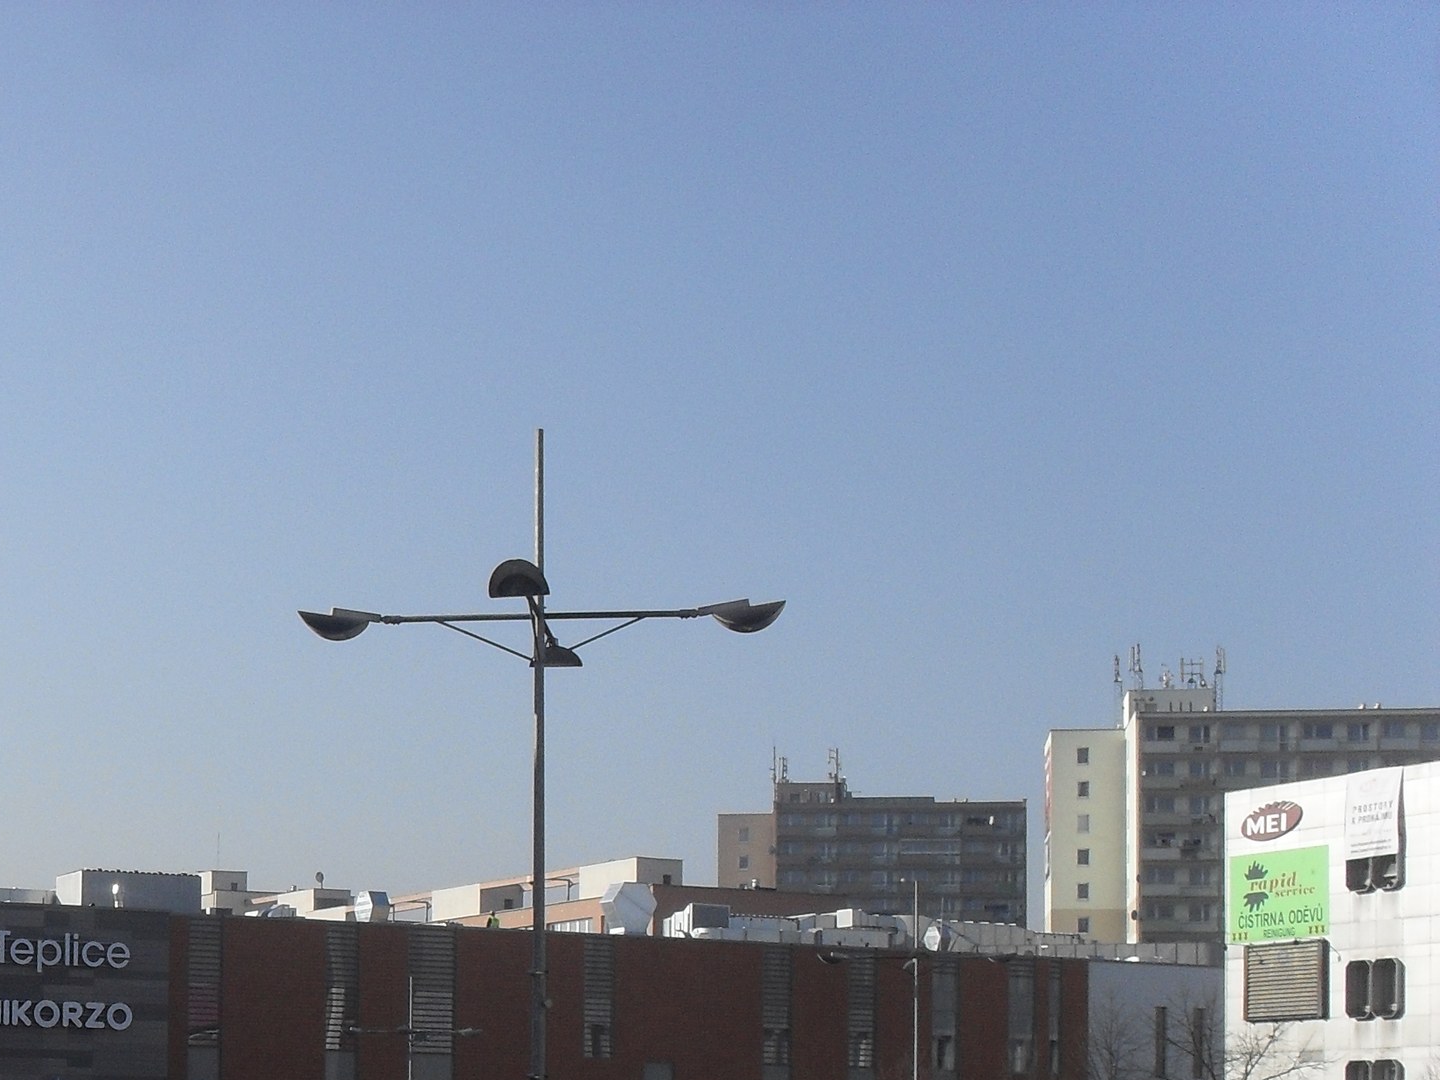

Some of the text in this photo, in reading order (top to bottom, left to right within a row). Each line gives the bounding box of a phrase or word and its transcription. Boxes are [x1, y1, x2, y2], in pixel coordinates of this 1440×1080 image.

[1247, 812, 1287, 836] MEI
[1250, 871, 1296, 894] rapid
[1274, 884, 1316, 898] service
[1288, 902, 1324, 925] ODĚVŮ
[1263, 927, 1296, 938] REINIGUNG
